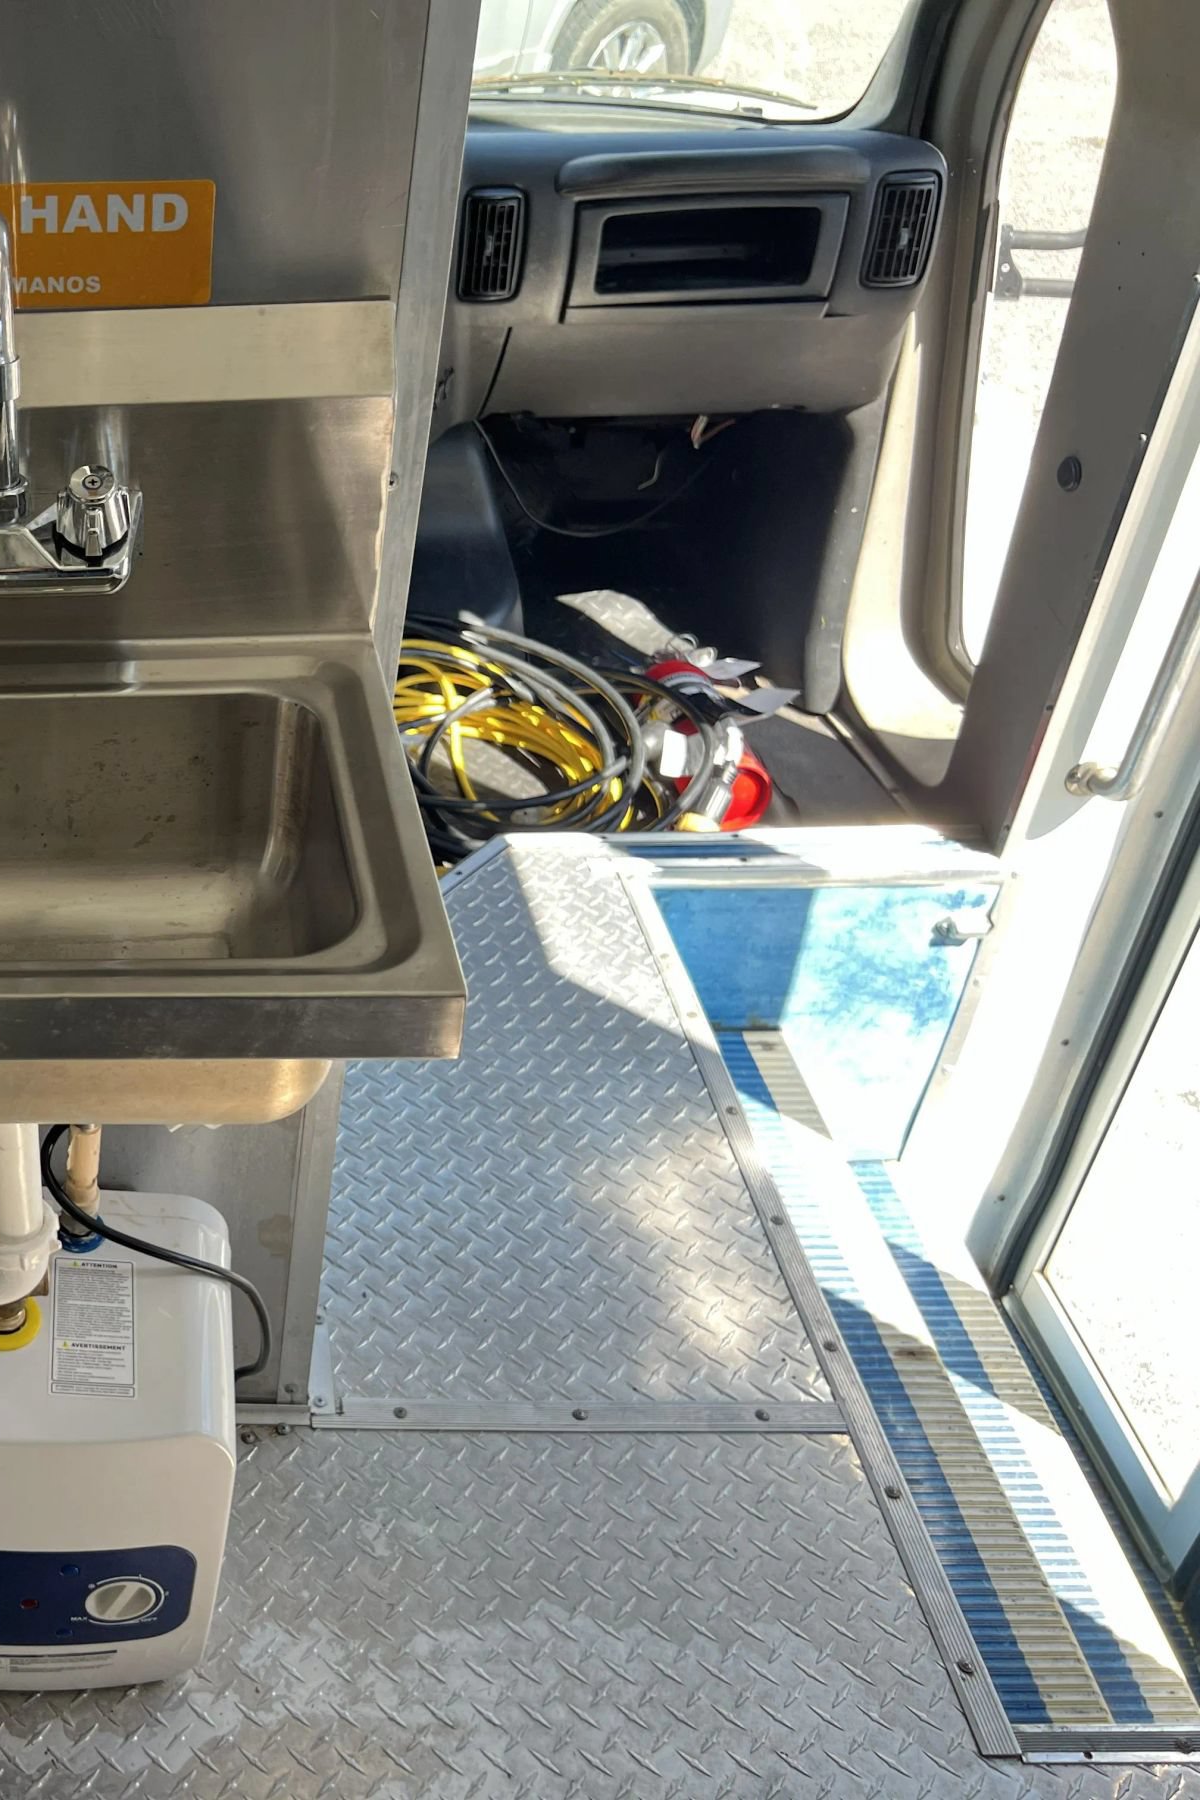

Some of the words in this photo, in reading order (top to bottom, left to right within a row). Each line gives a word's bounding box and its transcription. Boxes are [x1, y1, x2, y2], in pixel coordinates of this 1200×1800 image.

[20, 192, 189, 235] HAND
[13, 275, 101, 294] MANOS
[71, 1342, 126, 1351] AVERTISSEMENT
